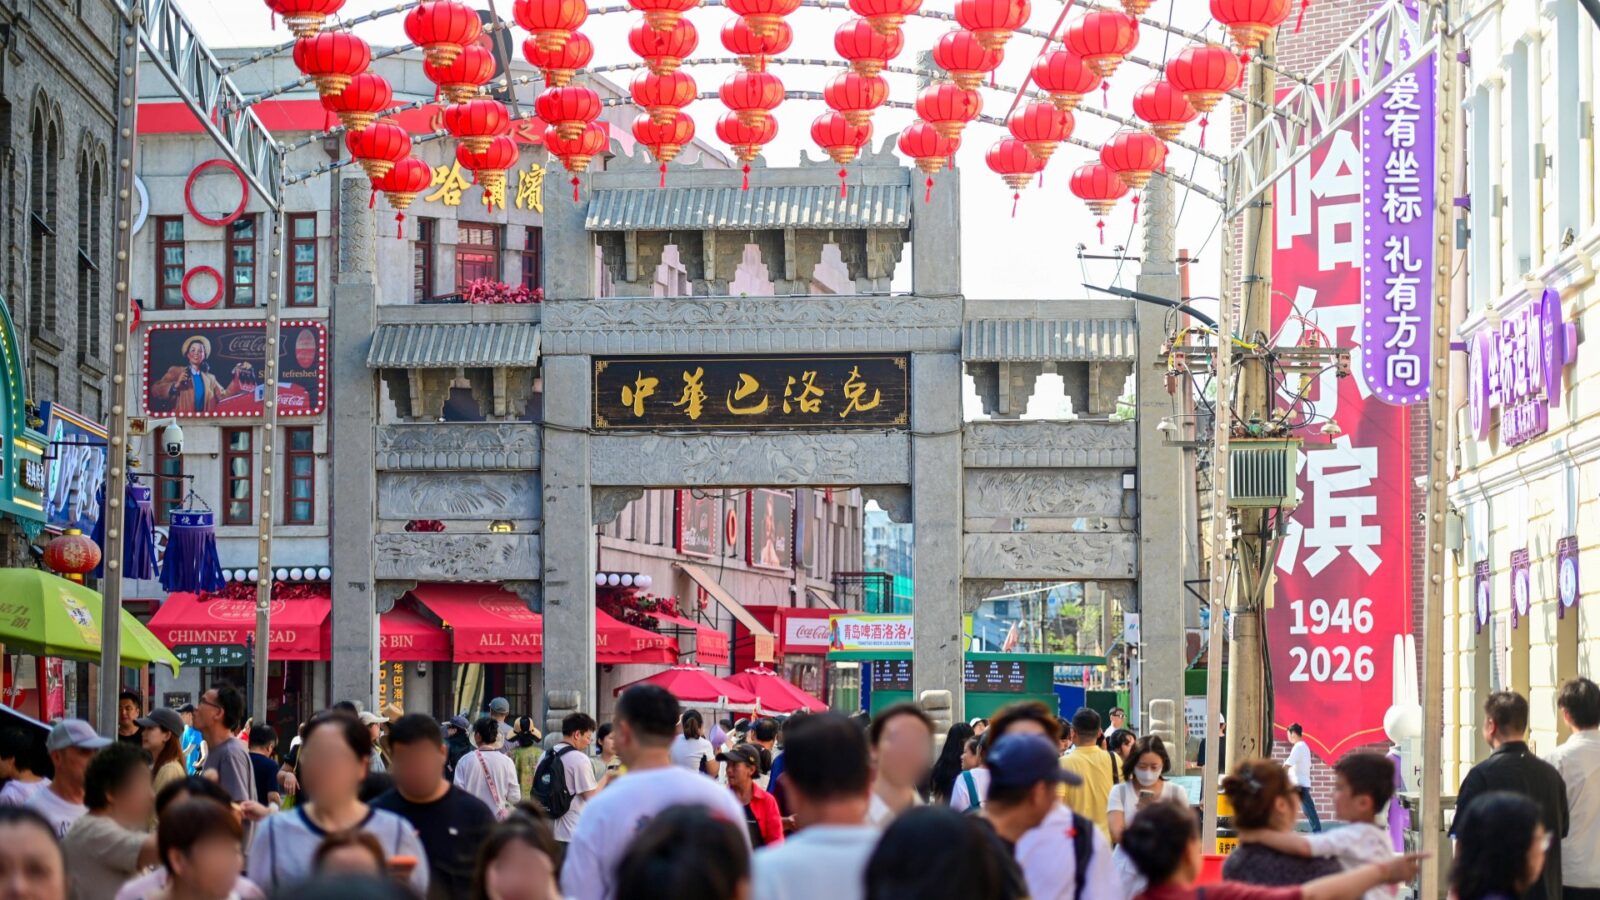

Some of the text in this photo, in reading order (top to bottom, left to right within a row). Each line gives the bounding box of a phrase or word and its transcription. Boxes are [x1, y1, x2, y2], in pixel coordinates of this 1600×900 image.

[1381, 72, 1423, 387] 爱有坐标 礼有方向
[1289, 598, 1374, 635] 1946
[168, 630, 297, 643] CHIMNEY BEAD
[390, 635, 414, 648] BIN
[479, 634, 505, 646] ALL
[190, 656, 203, 664] jing
[219, 656, 228, 664] jie
[1289, 646, 1375, 682] 2026
